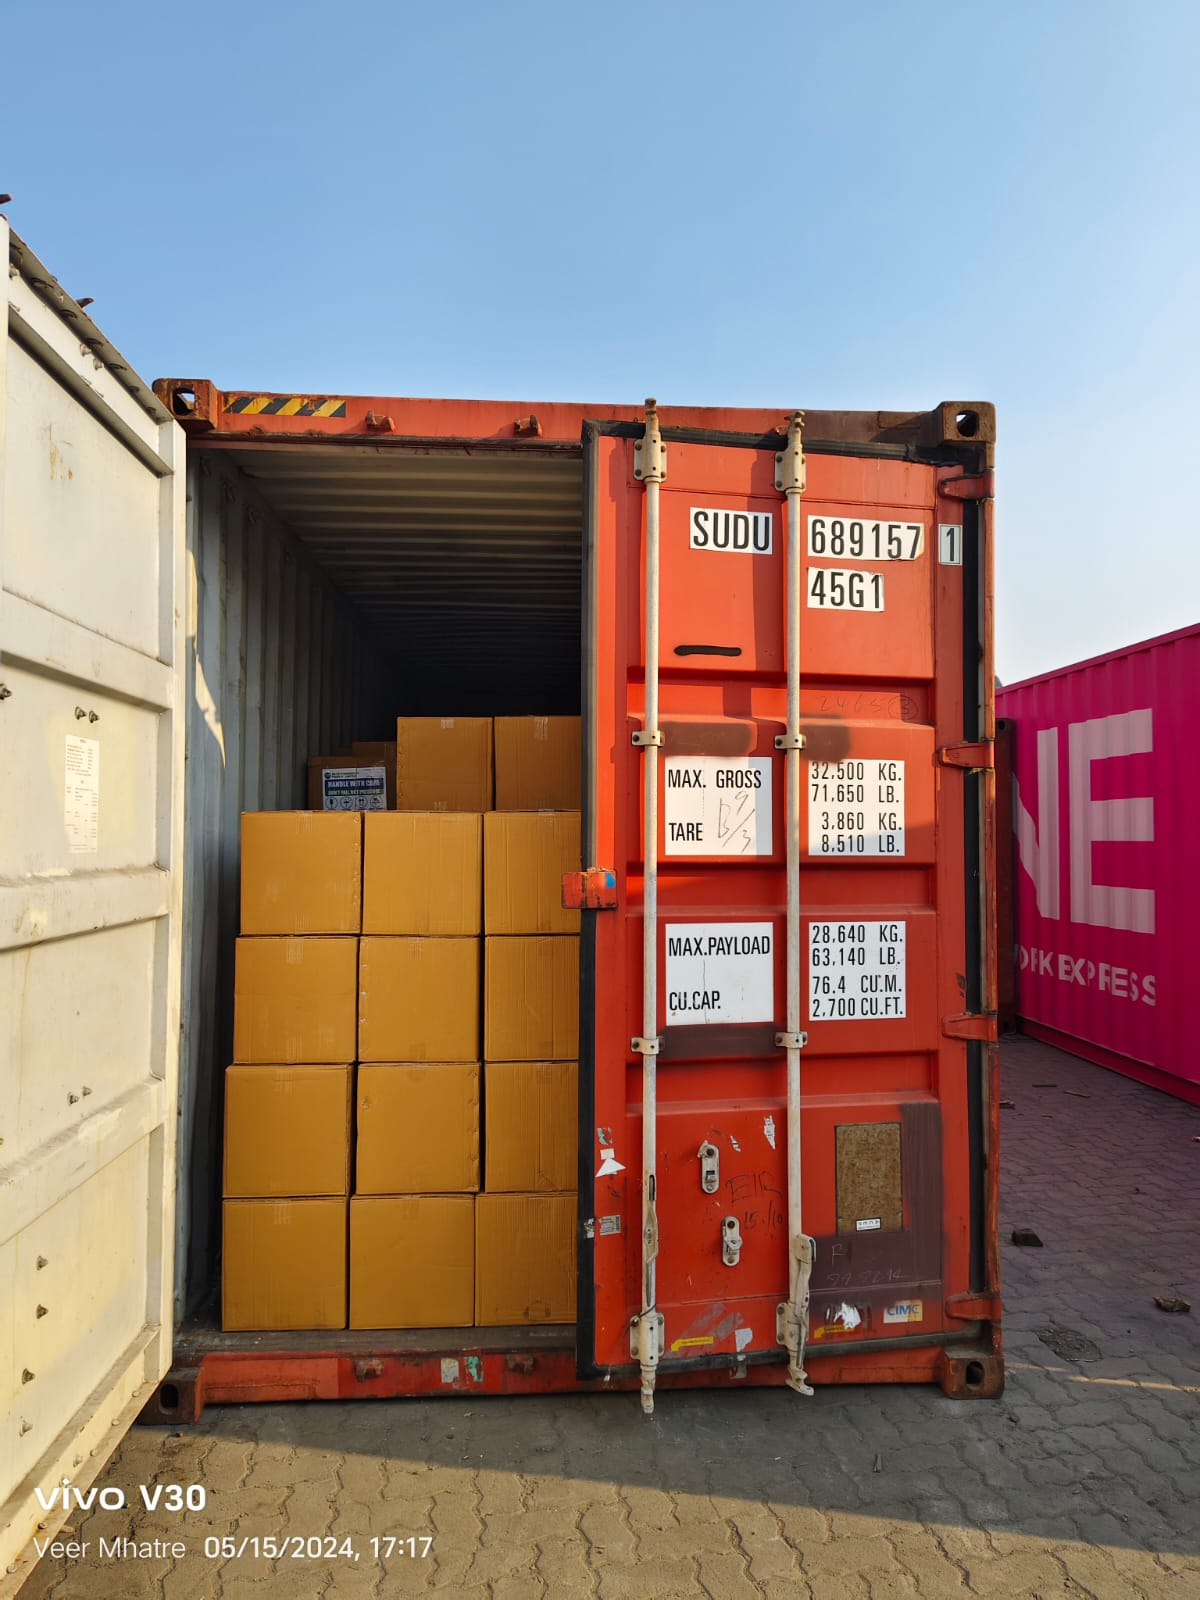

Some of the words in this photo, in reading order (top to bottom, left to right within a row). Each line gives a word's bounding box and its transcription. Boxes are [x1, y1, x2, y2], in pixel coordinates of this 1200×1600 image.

[693, 510, 770, 551] SUDU
[811, 518, 921, 560] 689157
[946, 527, 956, 562] 1
[811, 570, 881, 609] 45G1
[668, 769, 707, 789] MAX.
[716, 770, 762, 789] GROSS
[812, 762, 864, 781] 32,500
[878, 763, 902, 781] KG.
[812, 784, 864, 803] 71,650
[878, 786, 899, 803] LB.
[821, 812, 864, 831] 3,860
[878, 813, 902, 831] KG.
[1012, 708, 1155, 934] NE
[669, 823, 703, 842] TARE
[821, 835, 865, 853] 8,510
[878, 835, 900, 853] LB.
[812, 925, 866, 944] 28,640
[879, 925, 903, 943] KG.
[668, 936, 770, 957] MAX.PAYLOAD
[812, 948, 866, 967] 63,140
[879, 947, 901, 965] LB.
[812, 976, 846, 994] 76.4
[860, 975, 902, 993] CU.M.
[1058, 954, 1156, 1006] EXPRESS
[669, 991, 721, 1011] CU.CAP.
[812, 998, 856, 1018] 2,700
[860, 997, 903, 1016] CU.FT.
[887, 1304, 920, 1316] CIMC
